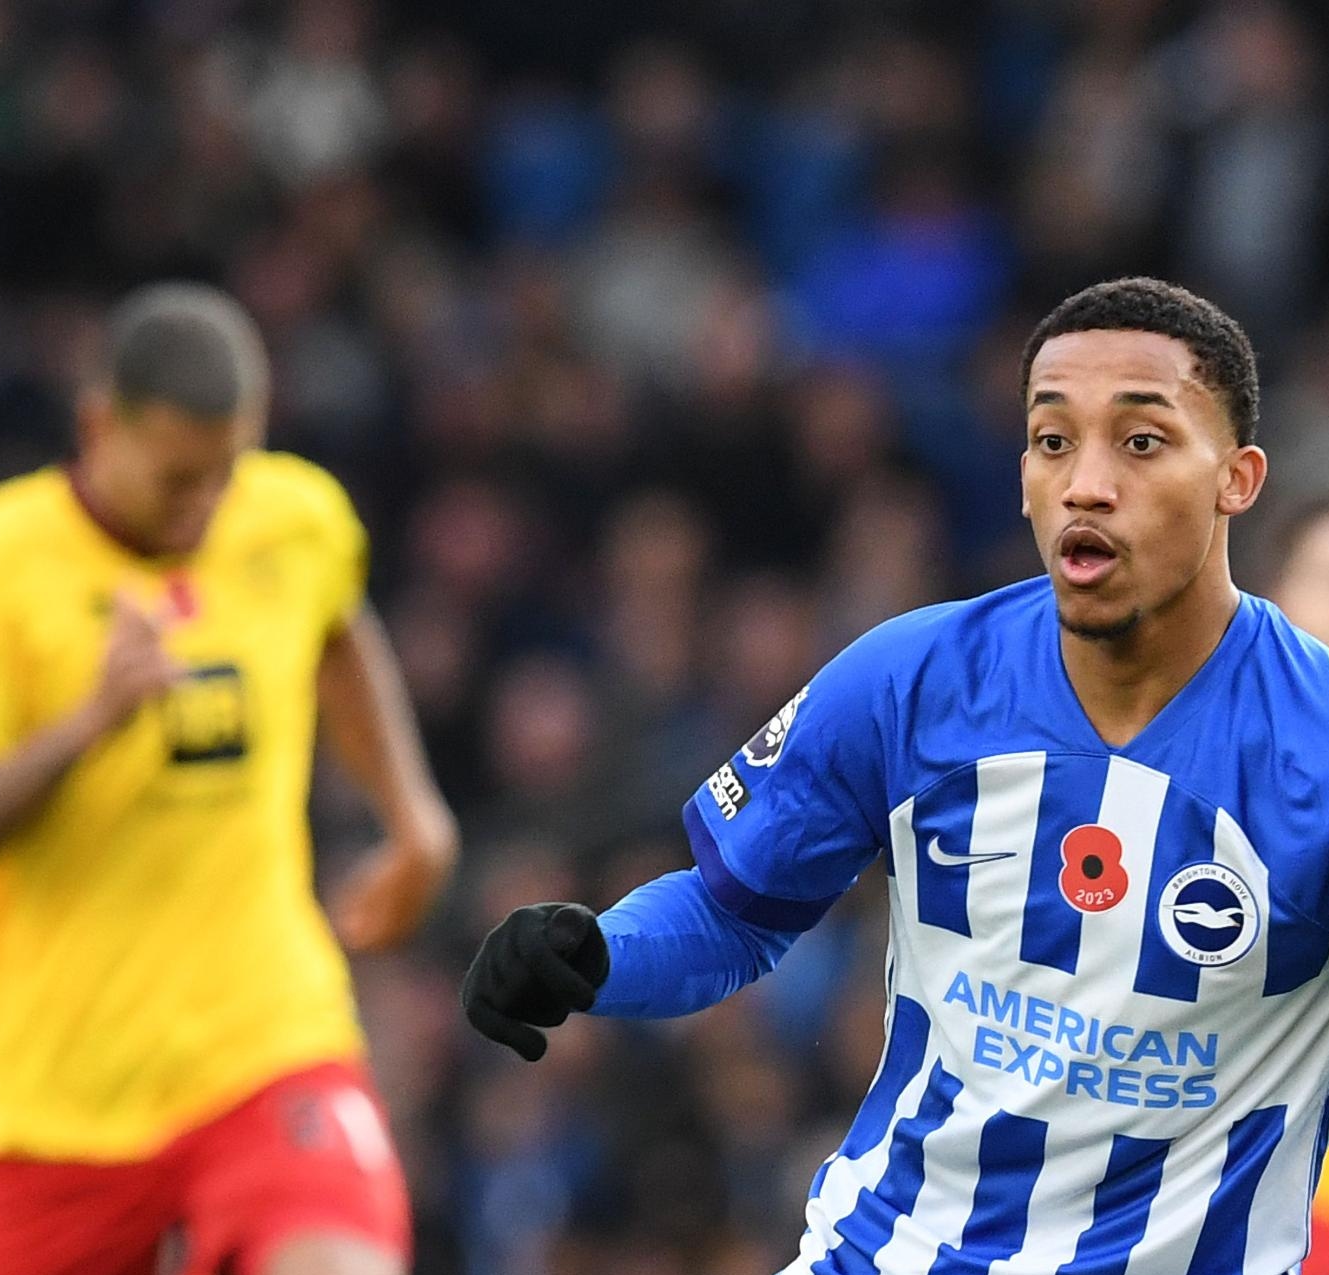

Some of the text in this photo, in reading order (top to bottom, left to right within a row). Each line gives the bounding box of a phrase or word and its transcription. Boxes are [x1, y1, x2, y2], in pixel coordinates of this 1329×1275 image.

[1075, 888, 1115, 906] 2023
[1229, 879, 1249, 901] HOVE
[1185, 949, 1224, 962] ALBION
[942, 970, 1219, 1068] AMERICAN
[972, 1025, 1218, 1110] EXPRESS
